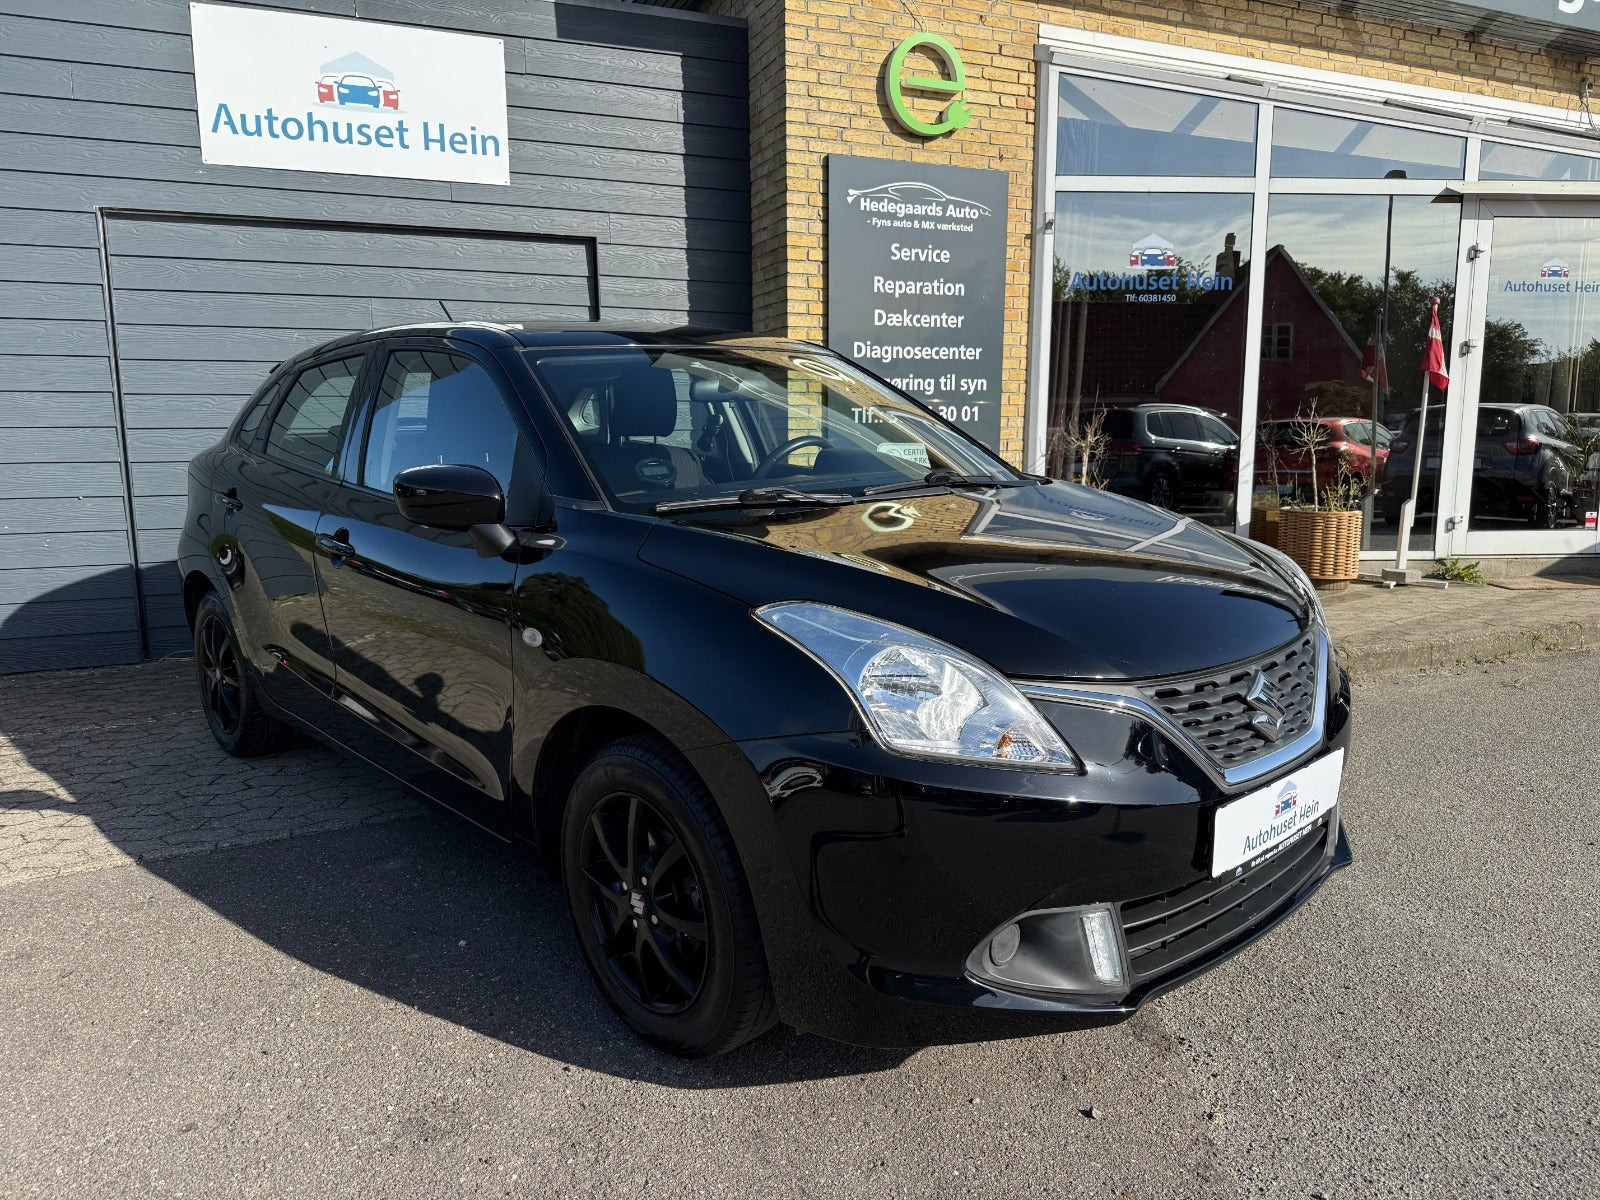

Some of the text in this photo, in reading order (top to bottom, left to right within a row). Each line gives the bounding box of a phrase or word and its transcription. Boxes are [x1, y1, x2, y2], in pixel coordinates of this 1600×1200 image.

[211, 103, 500, 157] Autohuset Hein
[860, 197, 979, 219] Hedegaards Auto
[872, 217, 891, 228] Fyns
[893, 219, 912, 228] auto
[913, 220, 920, 229] &
[921, 221, 935, 230] MX
[936, 223, 973, 232] værksted
[890, 243, 950, 263] Service
[873, 275, 965, 298] Reparation
[1069, 271, 1233, 292] Autohuset Hein
[1503, 280, 1571, 293] Autohuset
[1125, 294, 1177, 303] Tlf: 60381450
[873, 309, 964, 328] Dækcenter
[853, 341, 982, 363] Diagnosecenter
[884, 374, 987, 395] øring til syn
[961, 405, 979, 422] 01
[1243, 799, 1319, 855] Autohuset Hein
